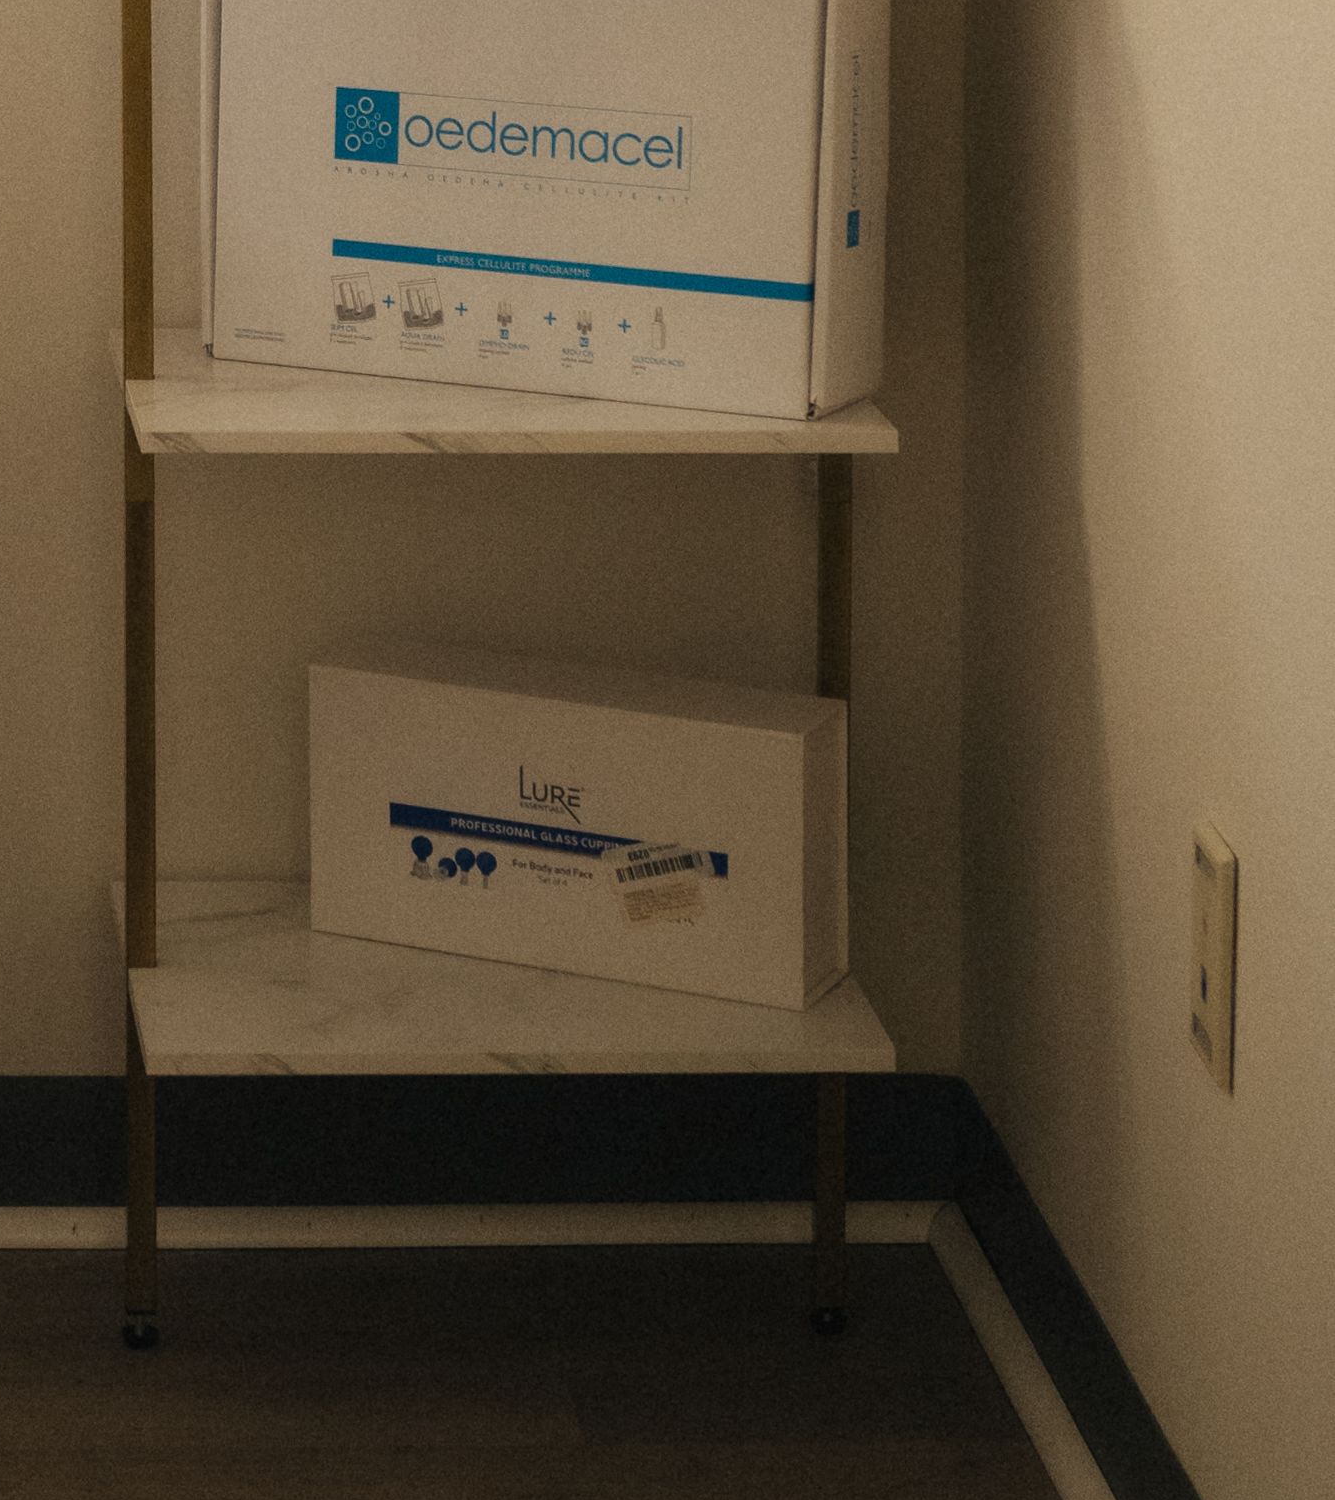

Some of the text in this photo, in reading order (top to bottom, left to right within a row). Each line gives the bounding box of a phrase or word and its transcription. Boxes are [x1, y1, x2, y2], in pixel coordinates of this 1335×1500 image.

[404, 110, 683, 170] oedemacel
[333, 165, 409, 179] AROSHA
[436, 254, 591, 278] EXPRESS CELLULITE PROGRAMME
[519, 801, 565, 815] ESSENTIALS
[449, 817, 624, 851] PROFESSIONAL GLASS CUPPI
[512, 858, 593, 879] For Body and Face
